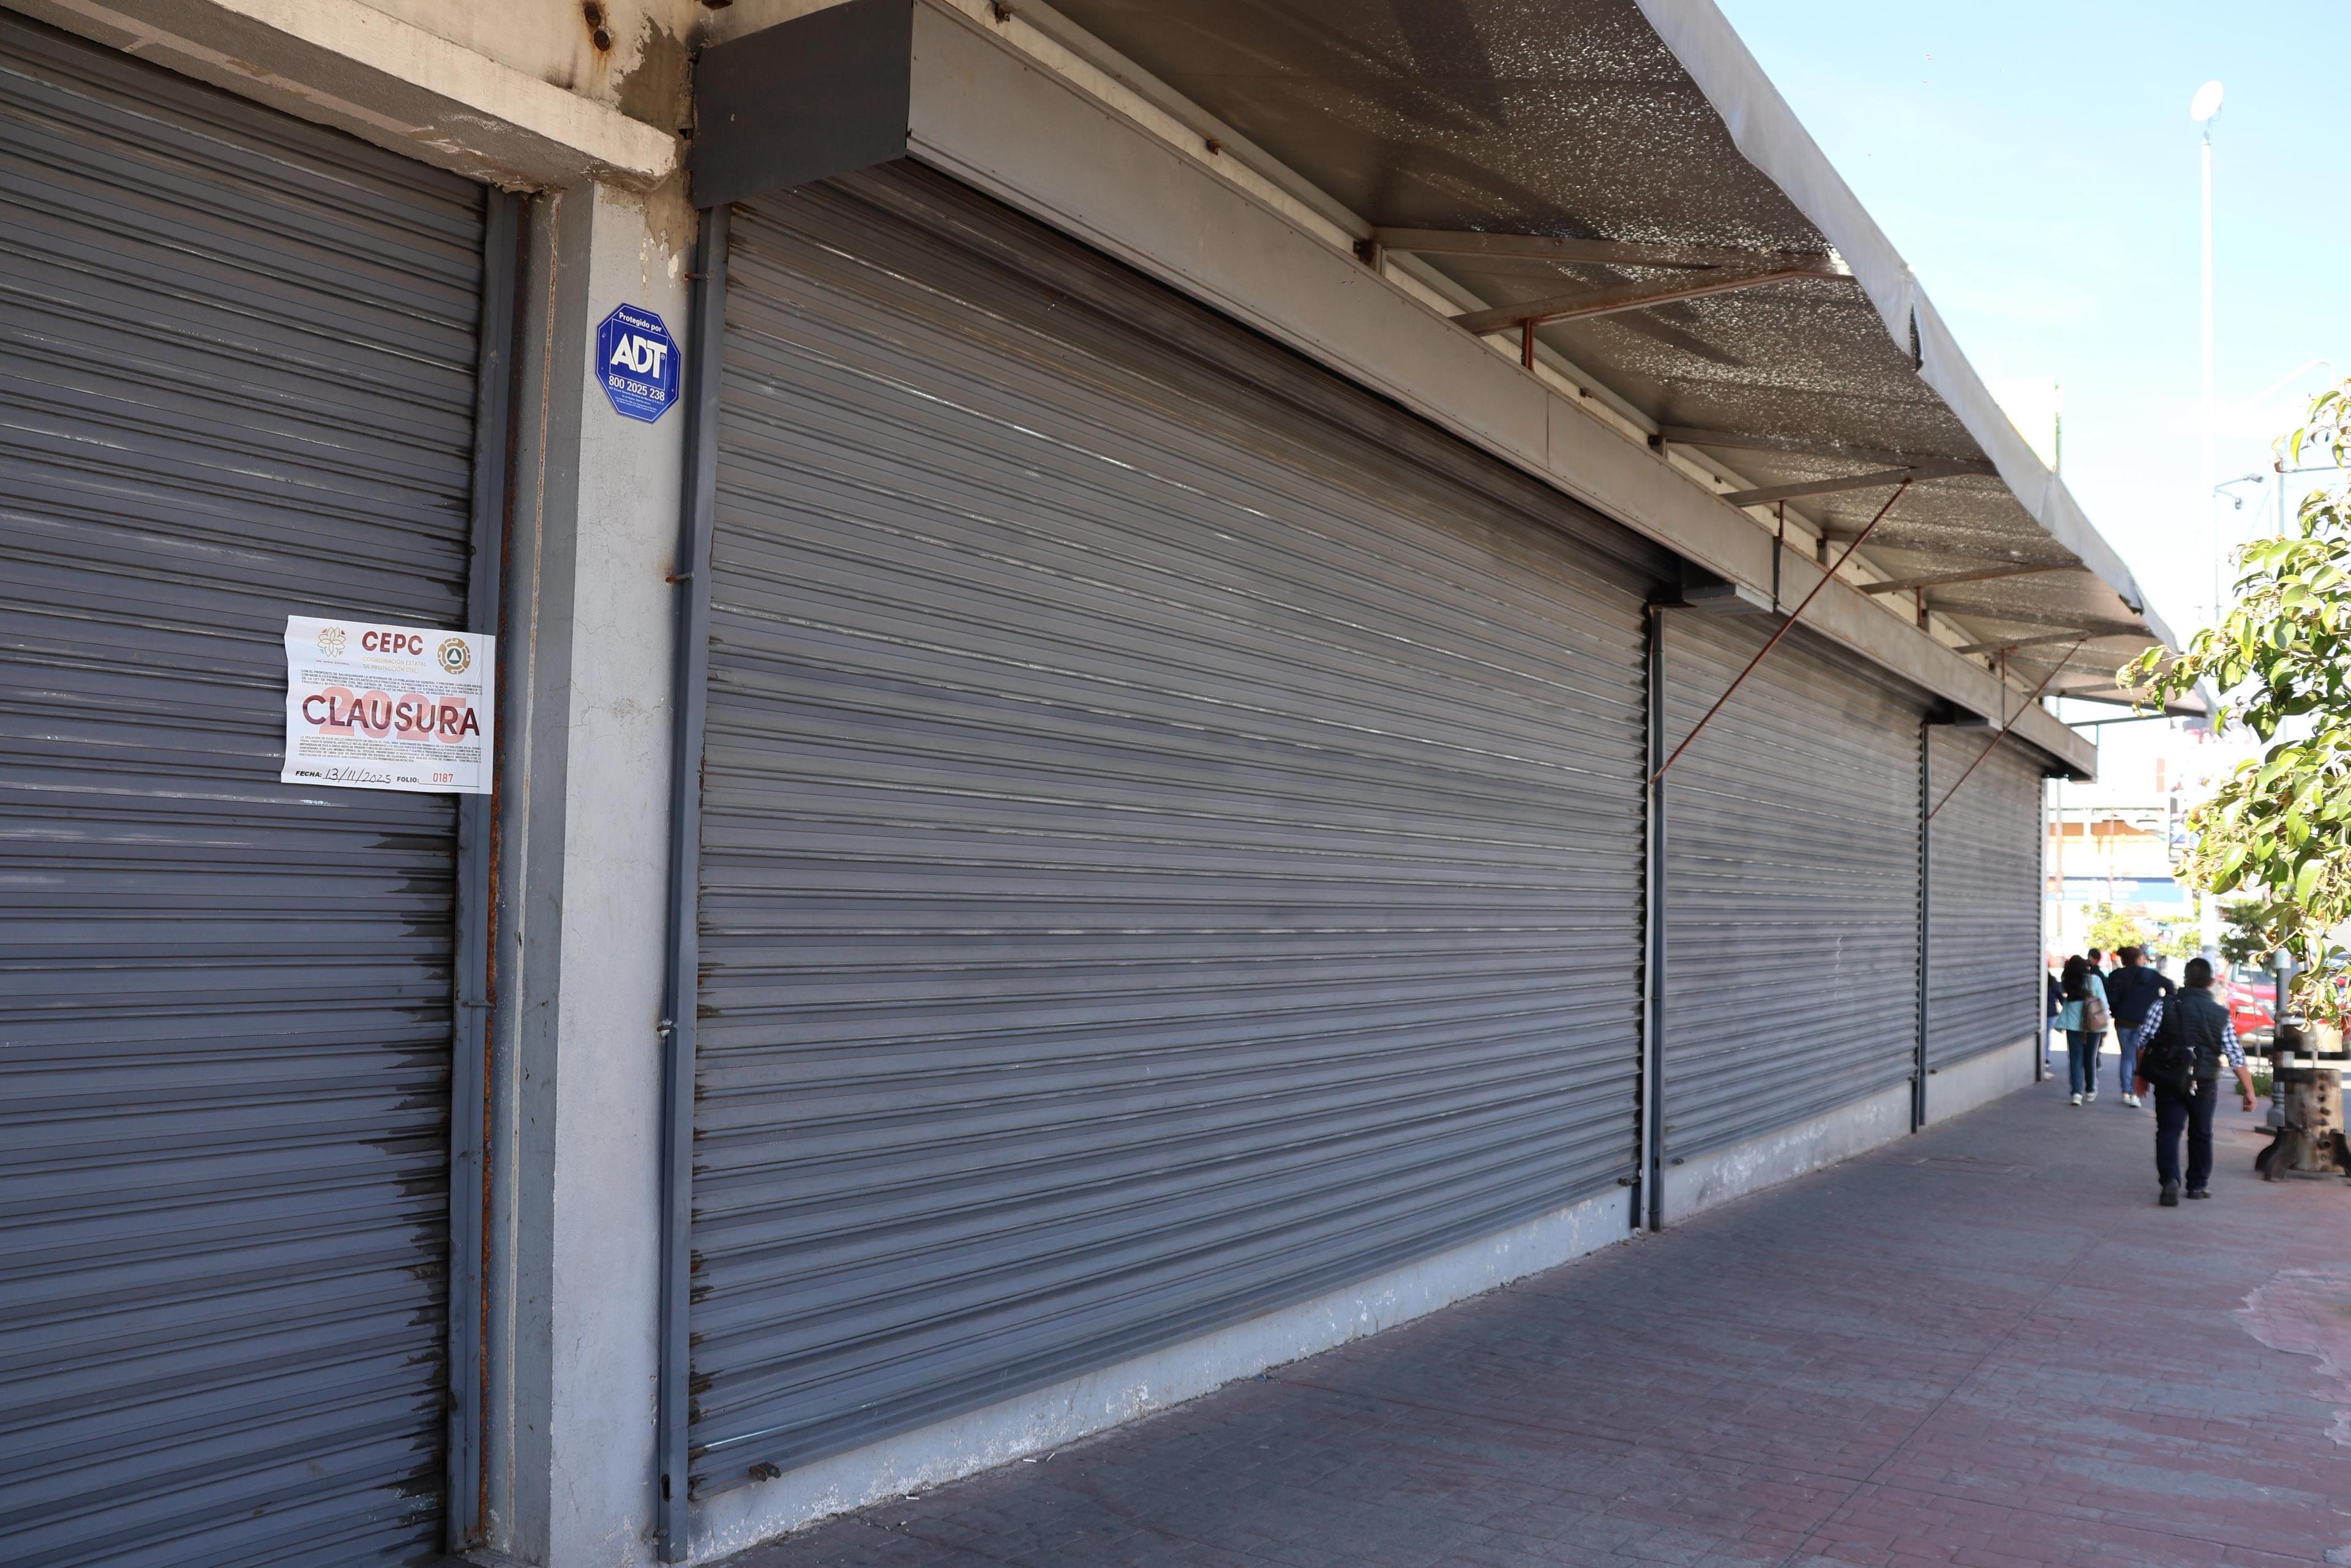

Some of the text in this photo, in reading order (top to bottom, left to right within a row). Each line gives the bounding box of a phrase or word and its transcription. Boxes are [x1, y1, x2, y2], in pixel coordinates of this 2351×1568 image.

[619, 312, 662, 332] Protegido por
[610, 332, 667, 378] ADT
[609, 376, 624, 389] 800
[627, 381, 647, 396] 2025
[650, 388, 665, 401] 238
[362, 631, 423, 655] CEPC
[302, 695, 480, 736] CLAUSURA
[319, 686, 467, 743] 2025
[325, 766, 391, 784] 13/11/2025
[433, 773, 453, 783] 0187
